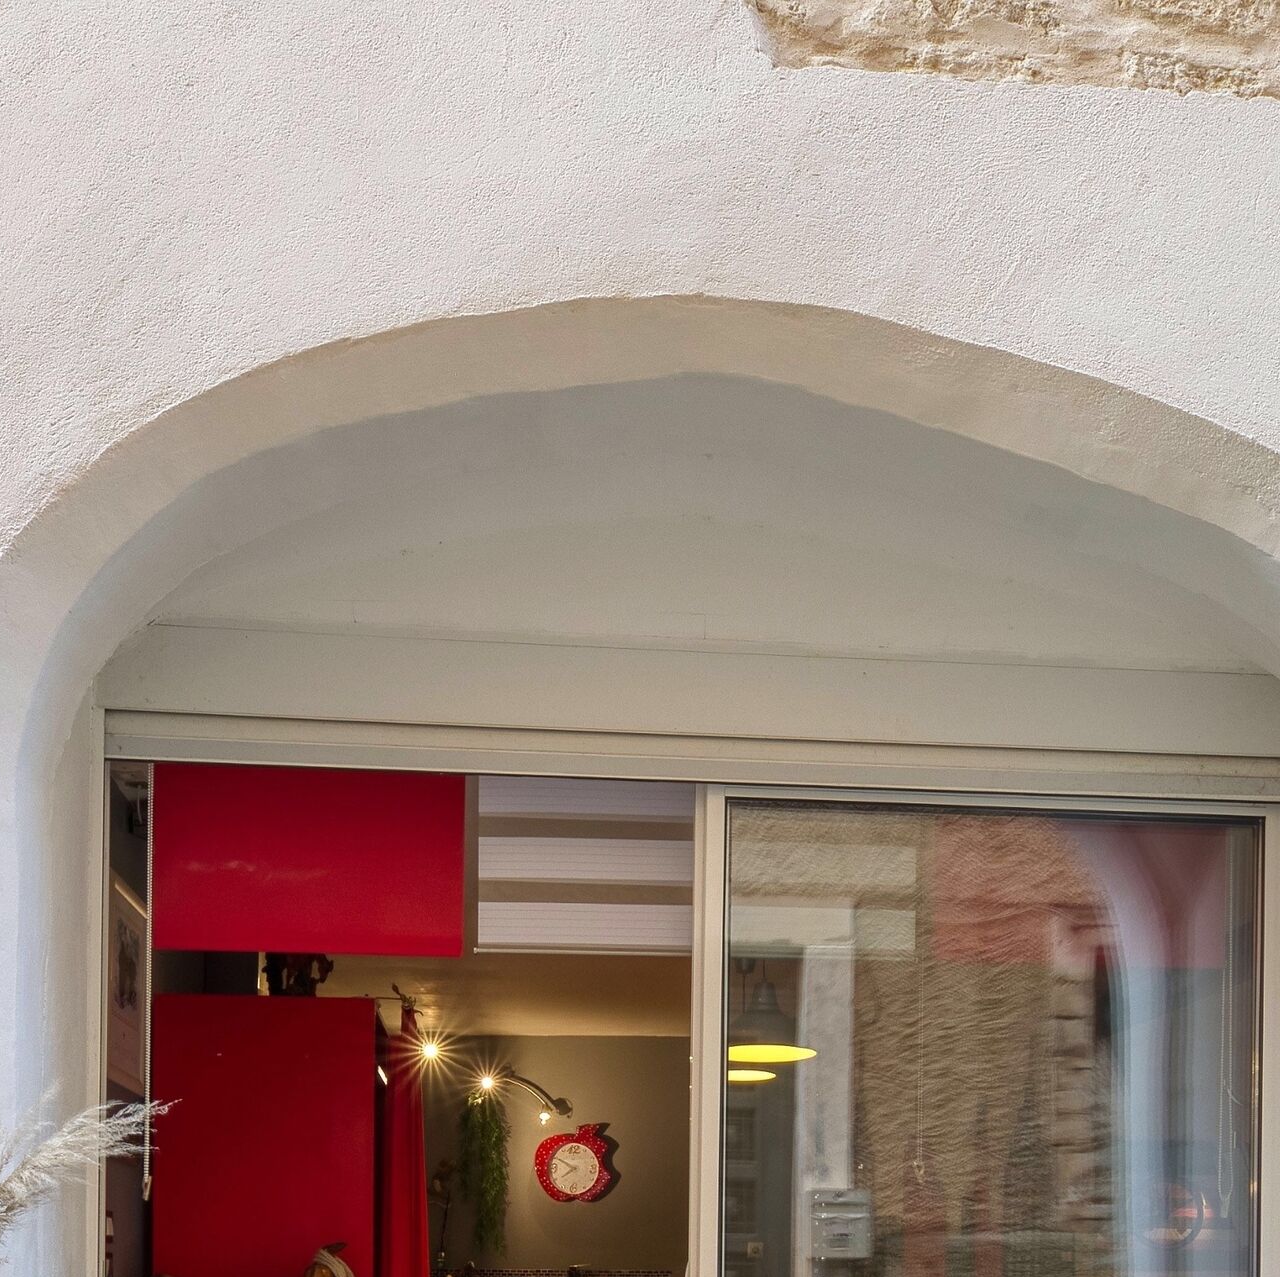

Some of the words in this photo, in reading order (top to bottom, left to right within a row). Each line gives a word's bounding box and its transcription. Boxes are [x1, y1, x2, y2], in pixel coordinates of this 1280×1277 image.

[567, 1145, 581, 1155] 12
[589, 1164, 597, 1174] 3
[570, 1183, 577, 1193] 6
